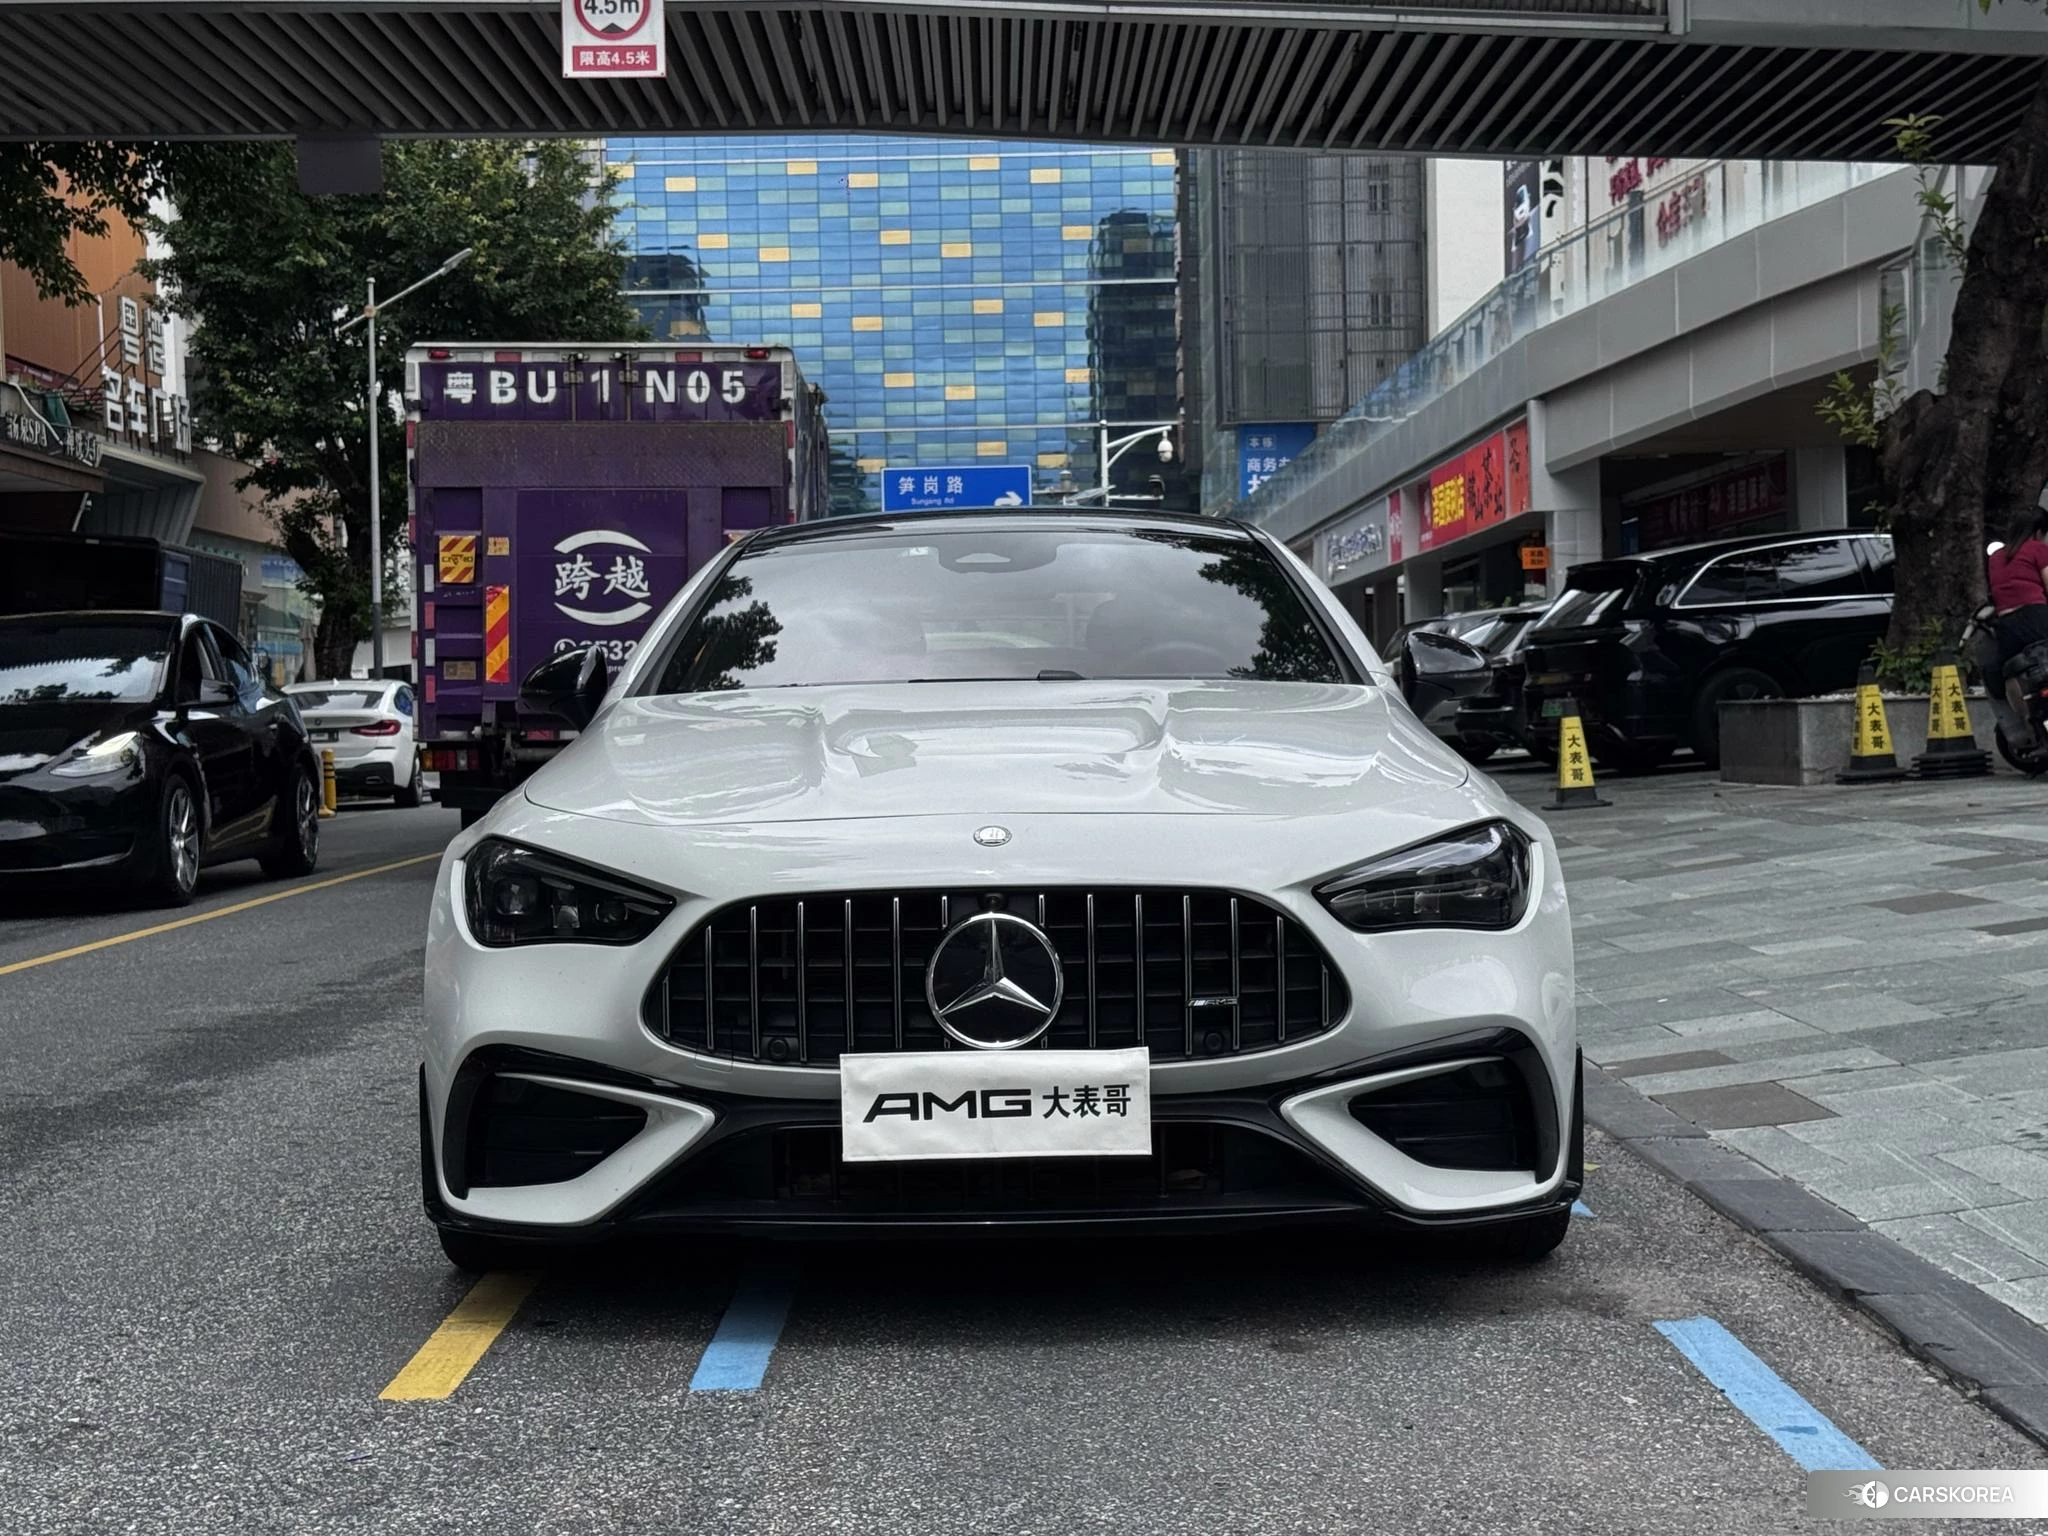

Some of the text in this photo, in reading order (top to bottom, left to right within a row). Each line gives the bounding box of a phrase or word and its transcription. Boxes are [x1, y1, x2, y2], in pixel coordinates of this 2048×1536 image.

[583, 0, 640, 14] 4.5m
[579, 50, 651, 66] 限高4.5米
[897, 475, 964, 496] 笋岗路
[554, 553, 652, 601] 跨越
[578, 639, 639, 662] 532
[1566, 734, 1585, 782] 大表哥
[862, 1083, 1132, 1123] AMG 大表哥
